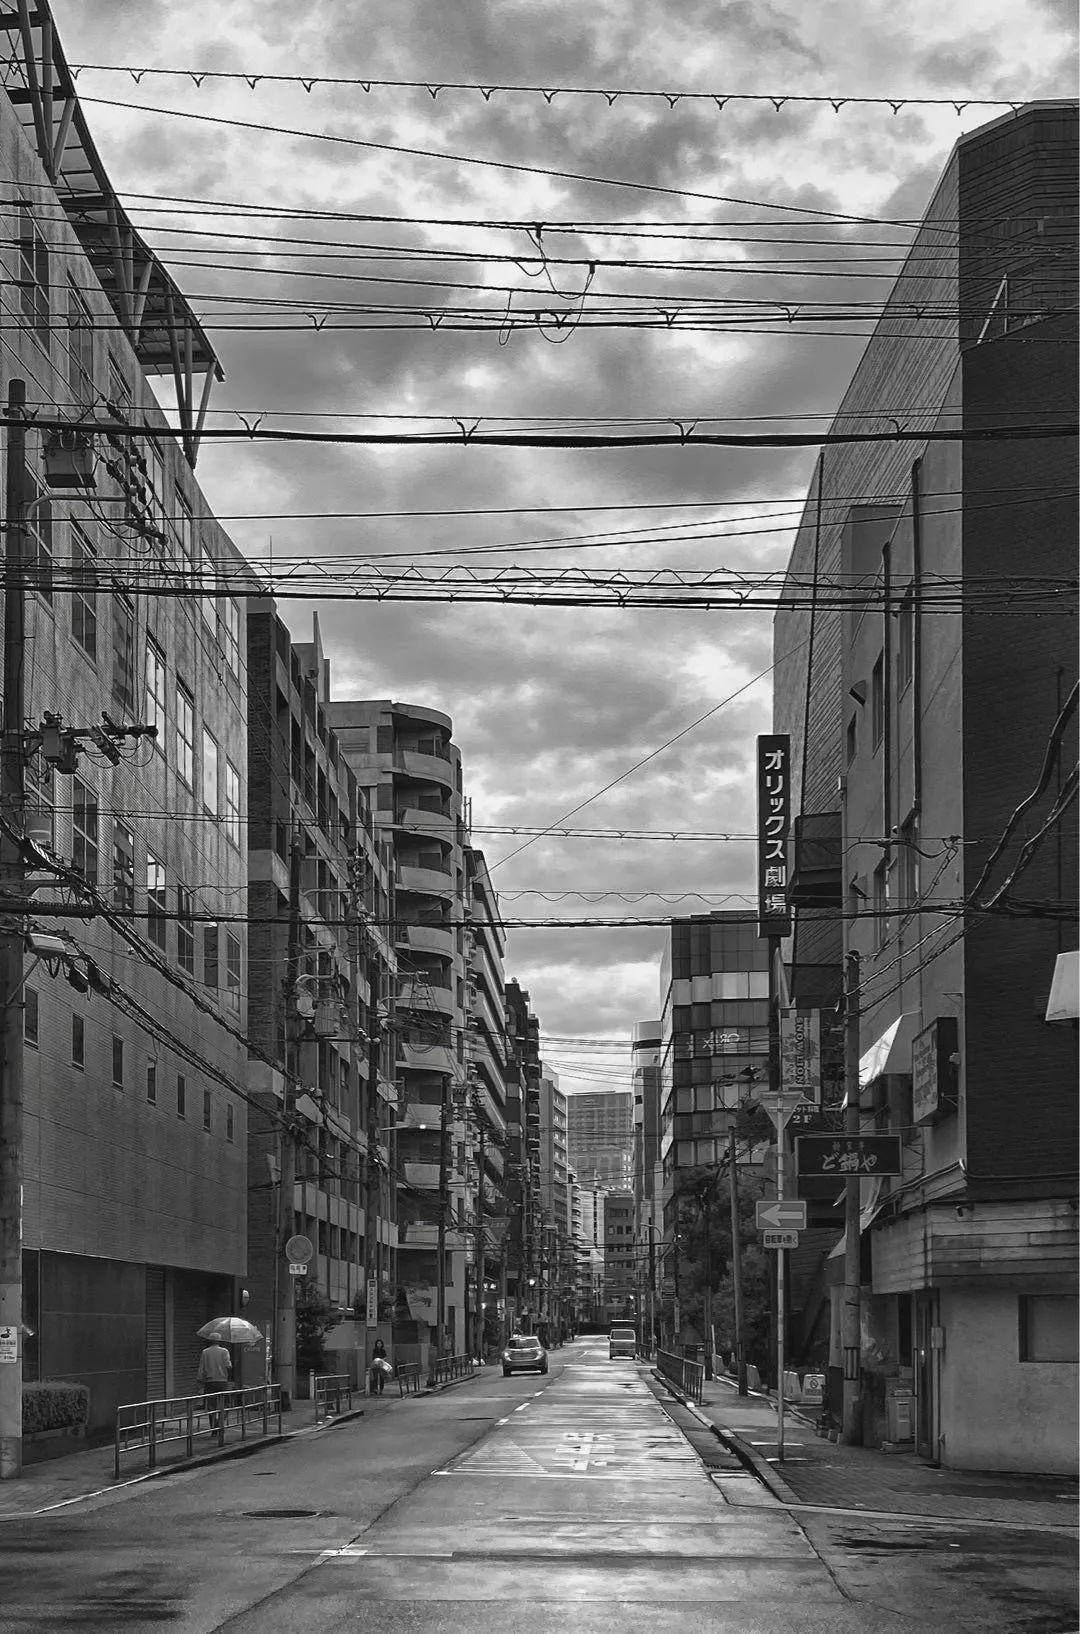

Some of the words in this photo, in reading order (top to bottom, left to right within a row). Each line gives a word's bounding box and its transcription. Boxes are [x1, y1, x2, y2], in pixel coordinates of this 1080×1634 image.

[765, 749, 787, 914] オリックス劇場
